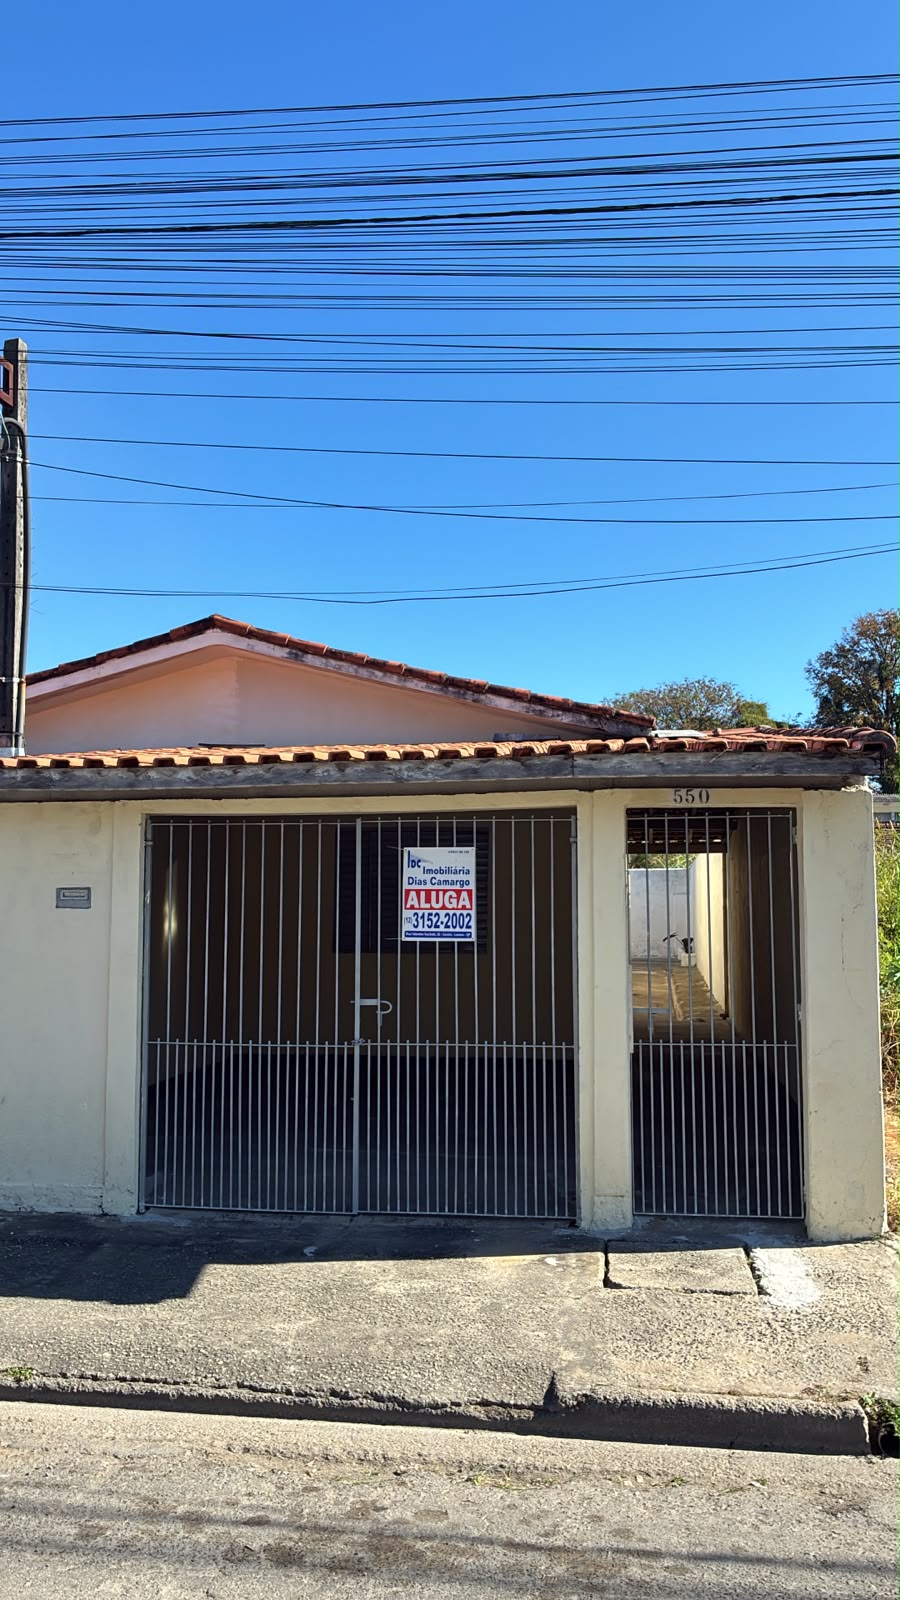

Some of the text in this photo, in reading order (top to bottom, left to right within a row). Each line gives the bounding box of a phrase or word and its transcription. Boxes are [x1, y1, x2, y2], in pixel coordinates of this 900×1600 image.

[673, 789, 710, 804] 550
[423, 866, 470, 875] Imobiliária
[407, 877, 470, 888] Dias Camargo
[406, 890, 472, 909] ALUGA
